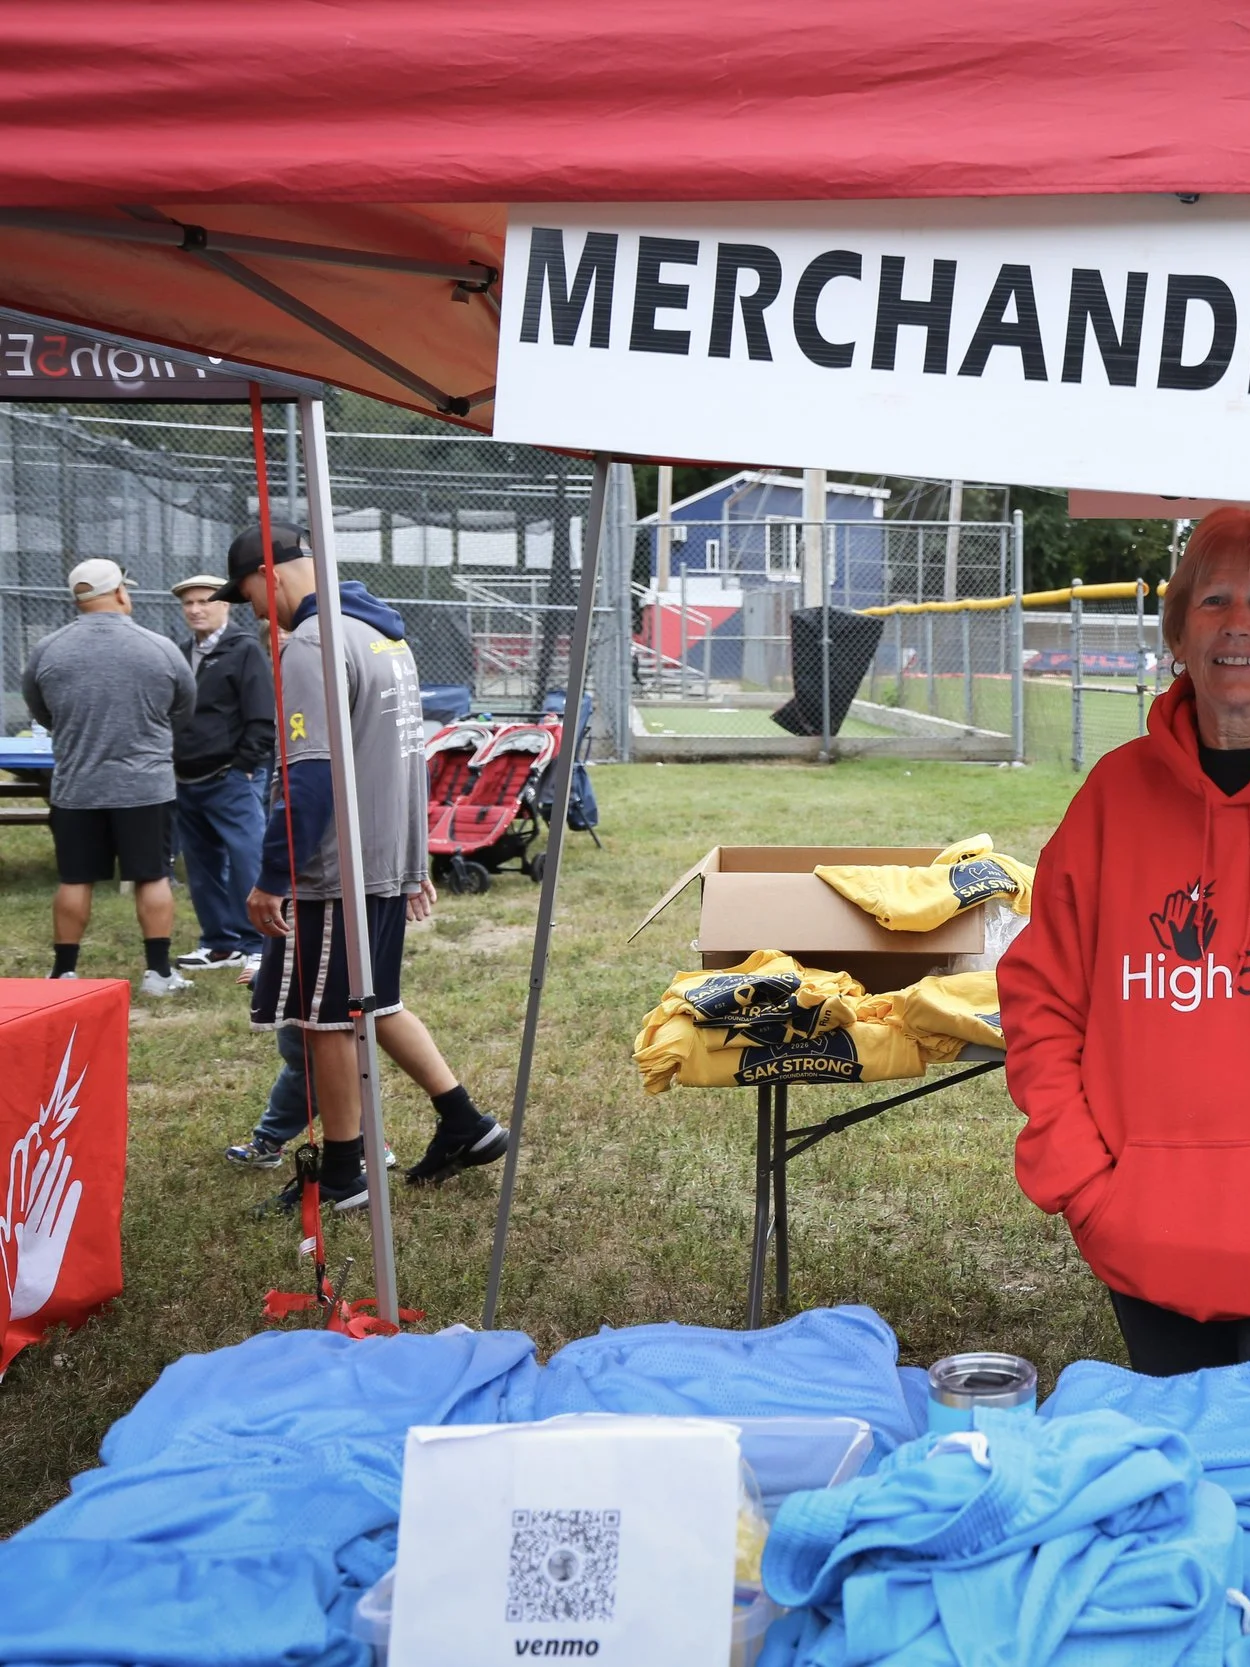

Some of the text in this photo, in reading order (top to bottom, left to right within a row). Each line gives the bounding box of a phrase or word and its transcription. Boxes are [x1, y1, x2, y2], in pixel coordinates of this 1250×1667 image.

[960, 882, 990, 897] SAK
[820, 1009, 832, 1027] Run
[743, 1058, 854, 1082] SAK STRONG
[779, 1072, 818, 1080] FOUNDATION
[515, 1637, 599, 1657] venmo
